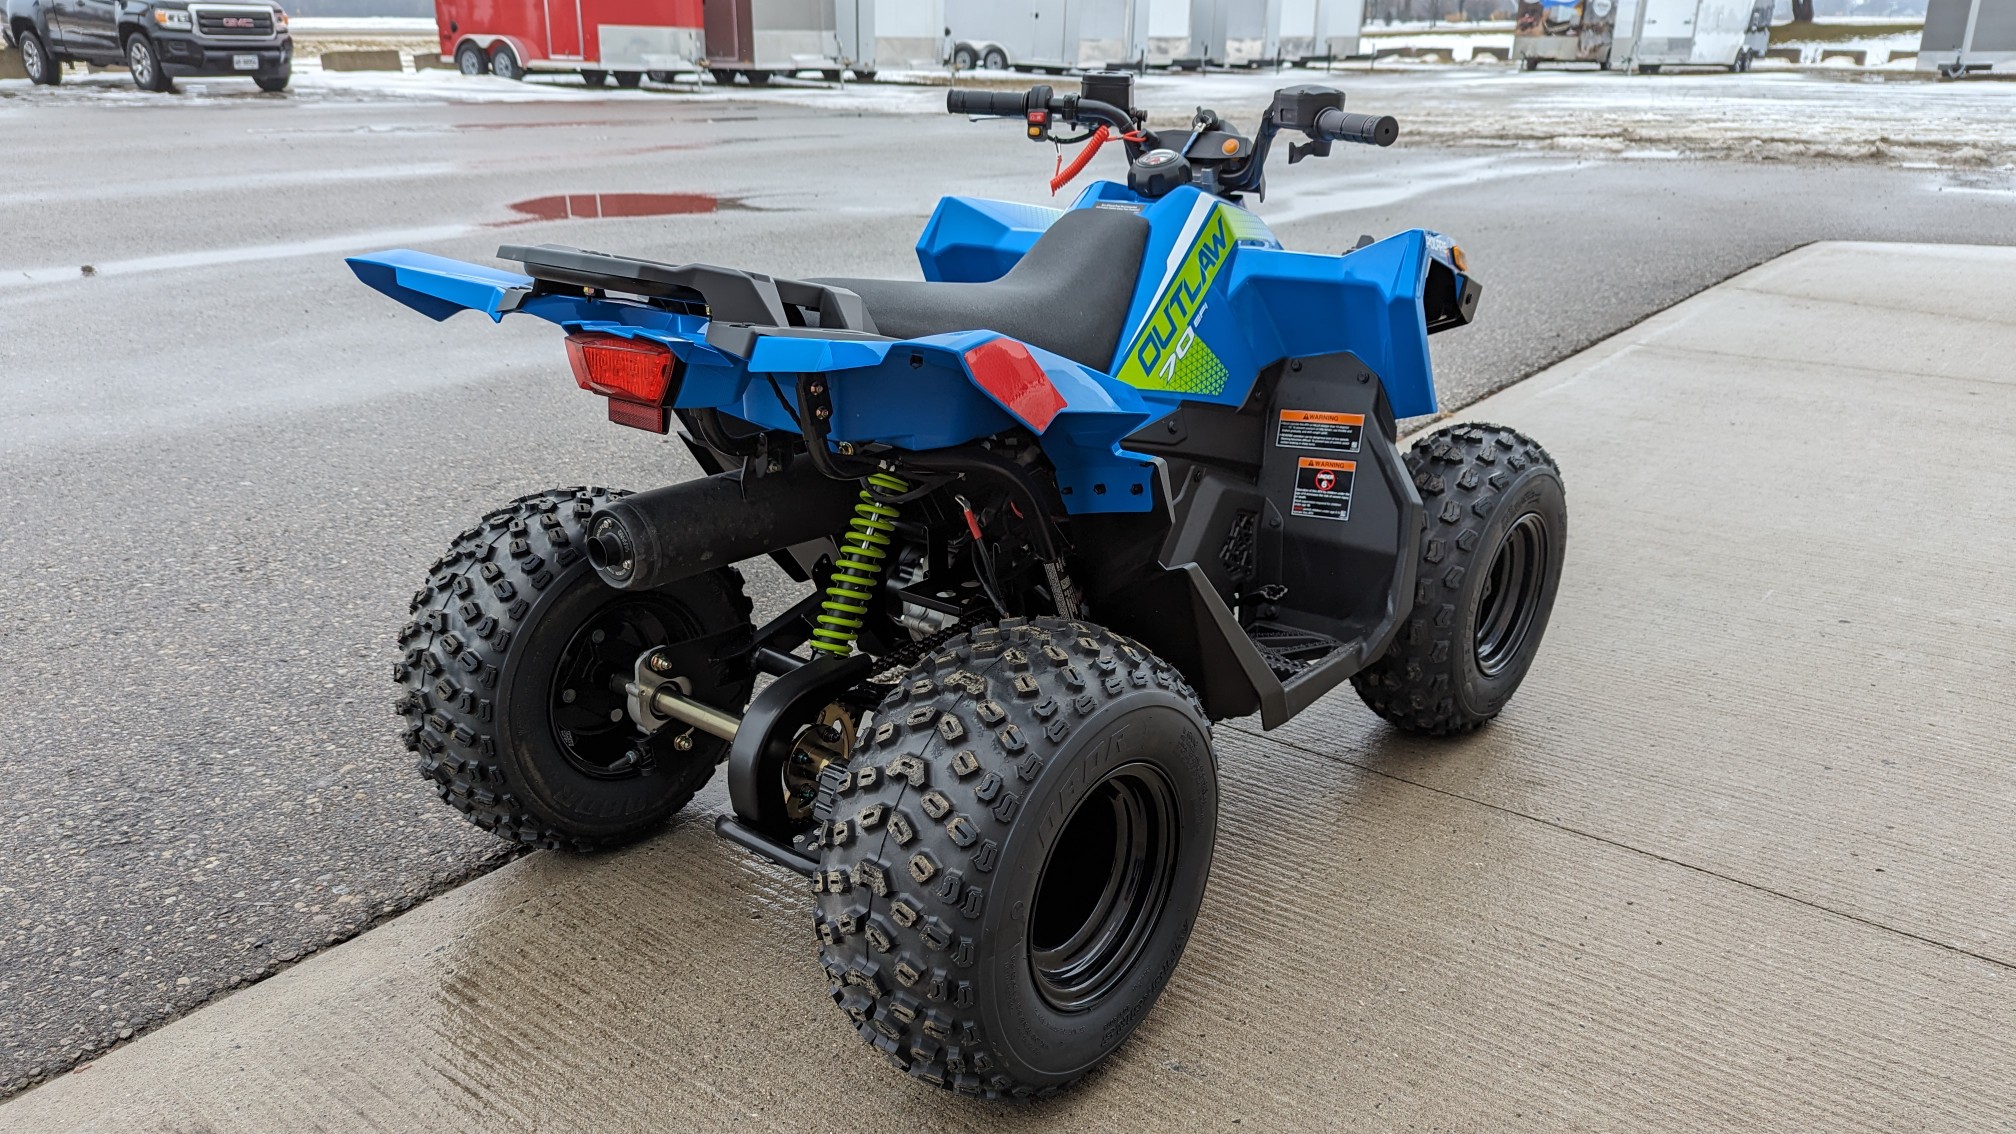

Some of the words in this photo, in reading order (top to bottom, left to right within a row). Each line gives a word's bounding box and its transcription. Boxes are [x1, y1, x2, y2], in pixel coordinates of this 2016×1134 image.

[223, 18, 254, 28] GMC
[1137, 216, 1227, 378] OUTLAW
[1158, 325, 1196, 384] 70
[1309, 413, 1339, 422] WARNING
[1315, 460, 1345, 469] WARNING
